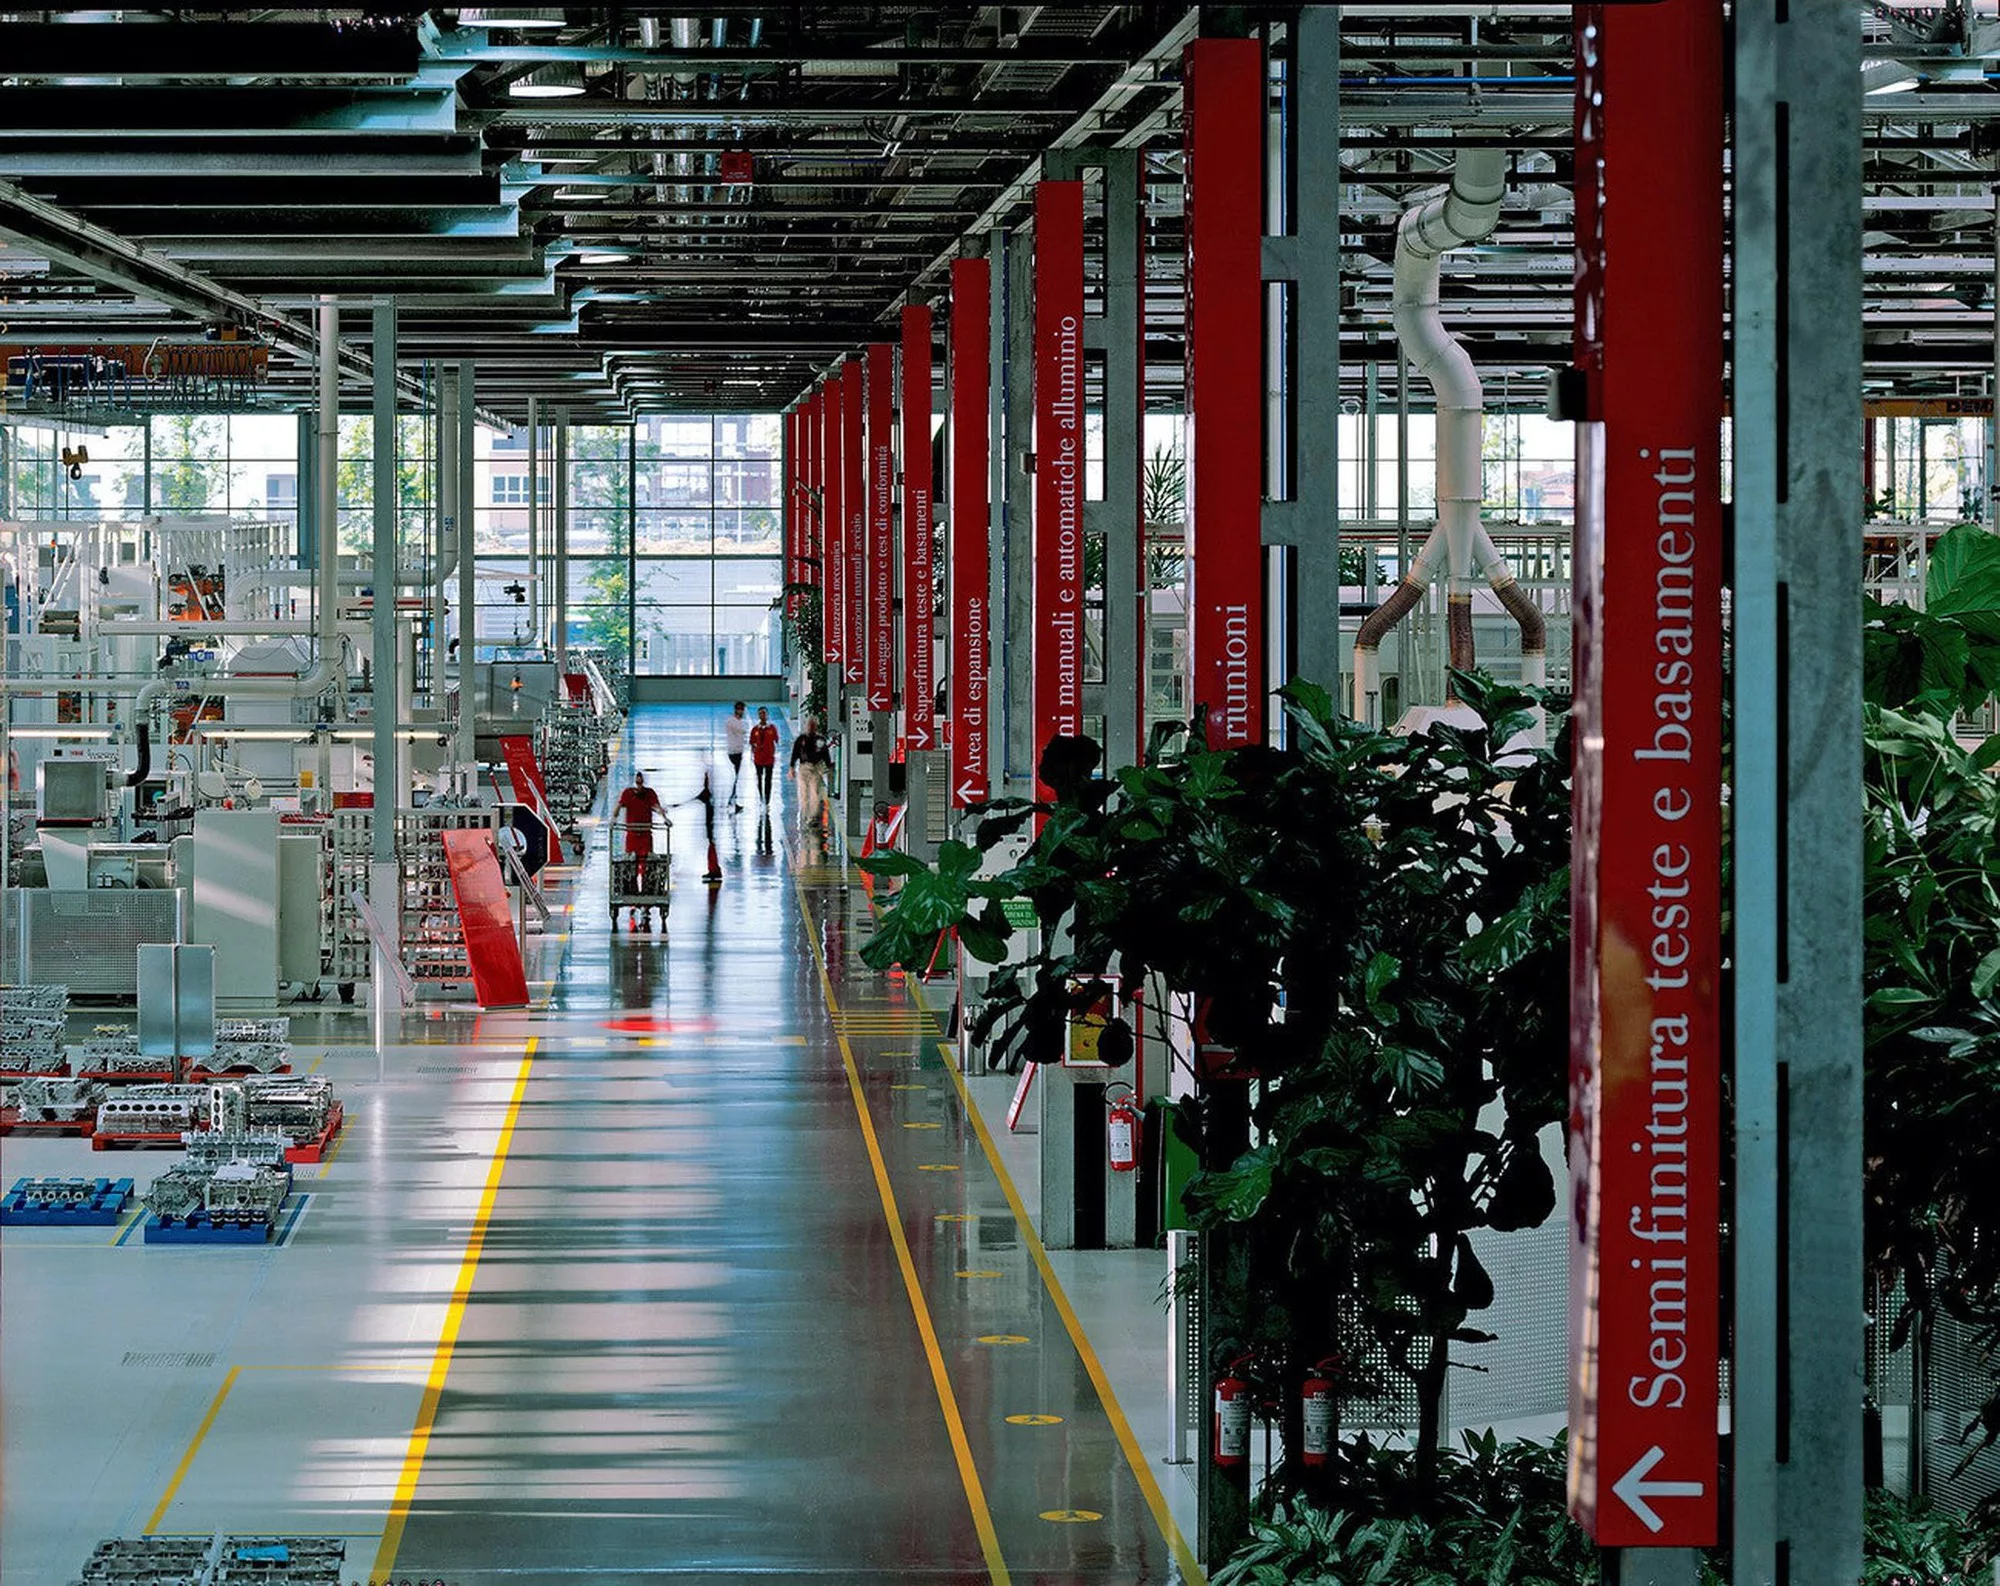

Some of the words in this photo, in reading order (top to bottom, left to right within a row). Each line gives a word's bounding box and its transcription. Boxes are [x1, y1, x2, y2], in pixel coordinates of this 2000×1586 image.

[1052, 316, 1077, 430] alluminio
[851, 513, 862, 550] acciaio
[875, 518, 888, 531] di
[911, 489, 929, 565] basamenti
[1052, 437, 1076, 580] automatiche
[831, 541, 841, 590] meccanica
[875, 535, 888, 557] test
[879, 561, 887, 569] e
[851, 554, 862, 597] manuali
[874, 573, 889, 627] prodotto
[917, 570, 928, 580] e
[1059, 589, 1075, 602] e
[914, 584, 929, 619] teste
[1634, 448, 1695, 763] basamenti
[851, 602, 863, 663] Lavorazioni
[963, 597, 986, 701] espansione
[873, 632, 889, 687] Lavaggio
[912, 623, 932, 722] Superfinitura
[1052, 611, 1075, 706] manuali
[1215, 603, 1248, 740] riunioni
[962, 707, 982, 726] di
[963, 731, 982, 775] Area
[1653, 787, 1691, 821] e
[1640, 844, 1690, 990] teste
